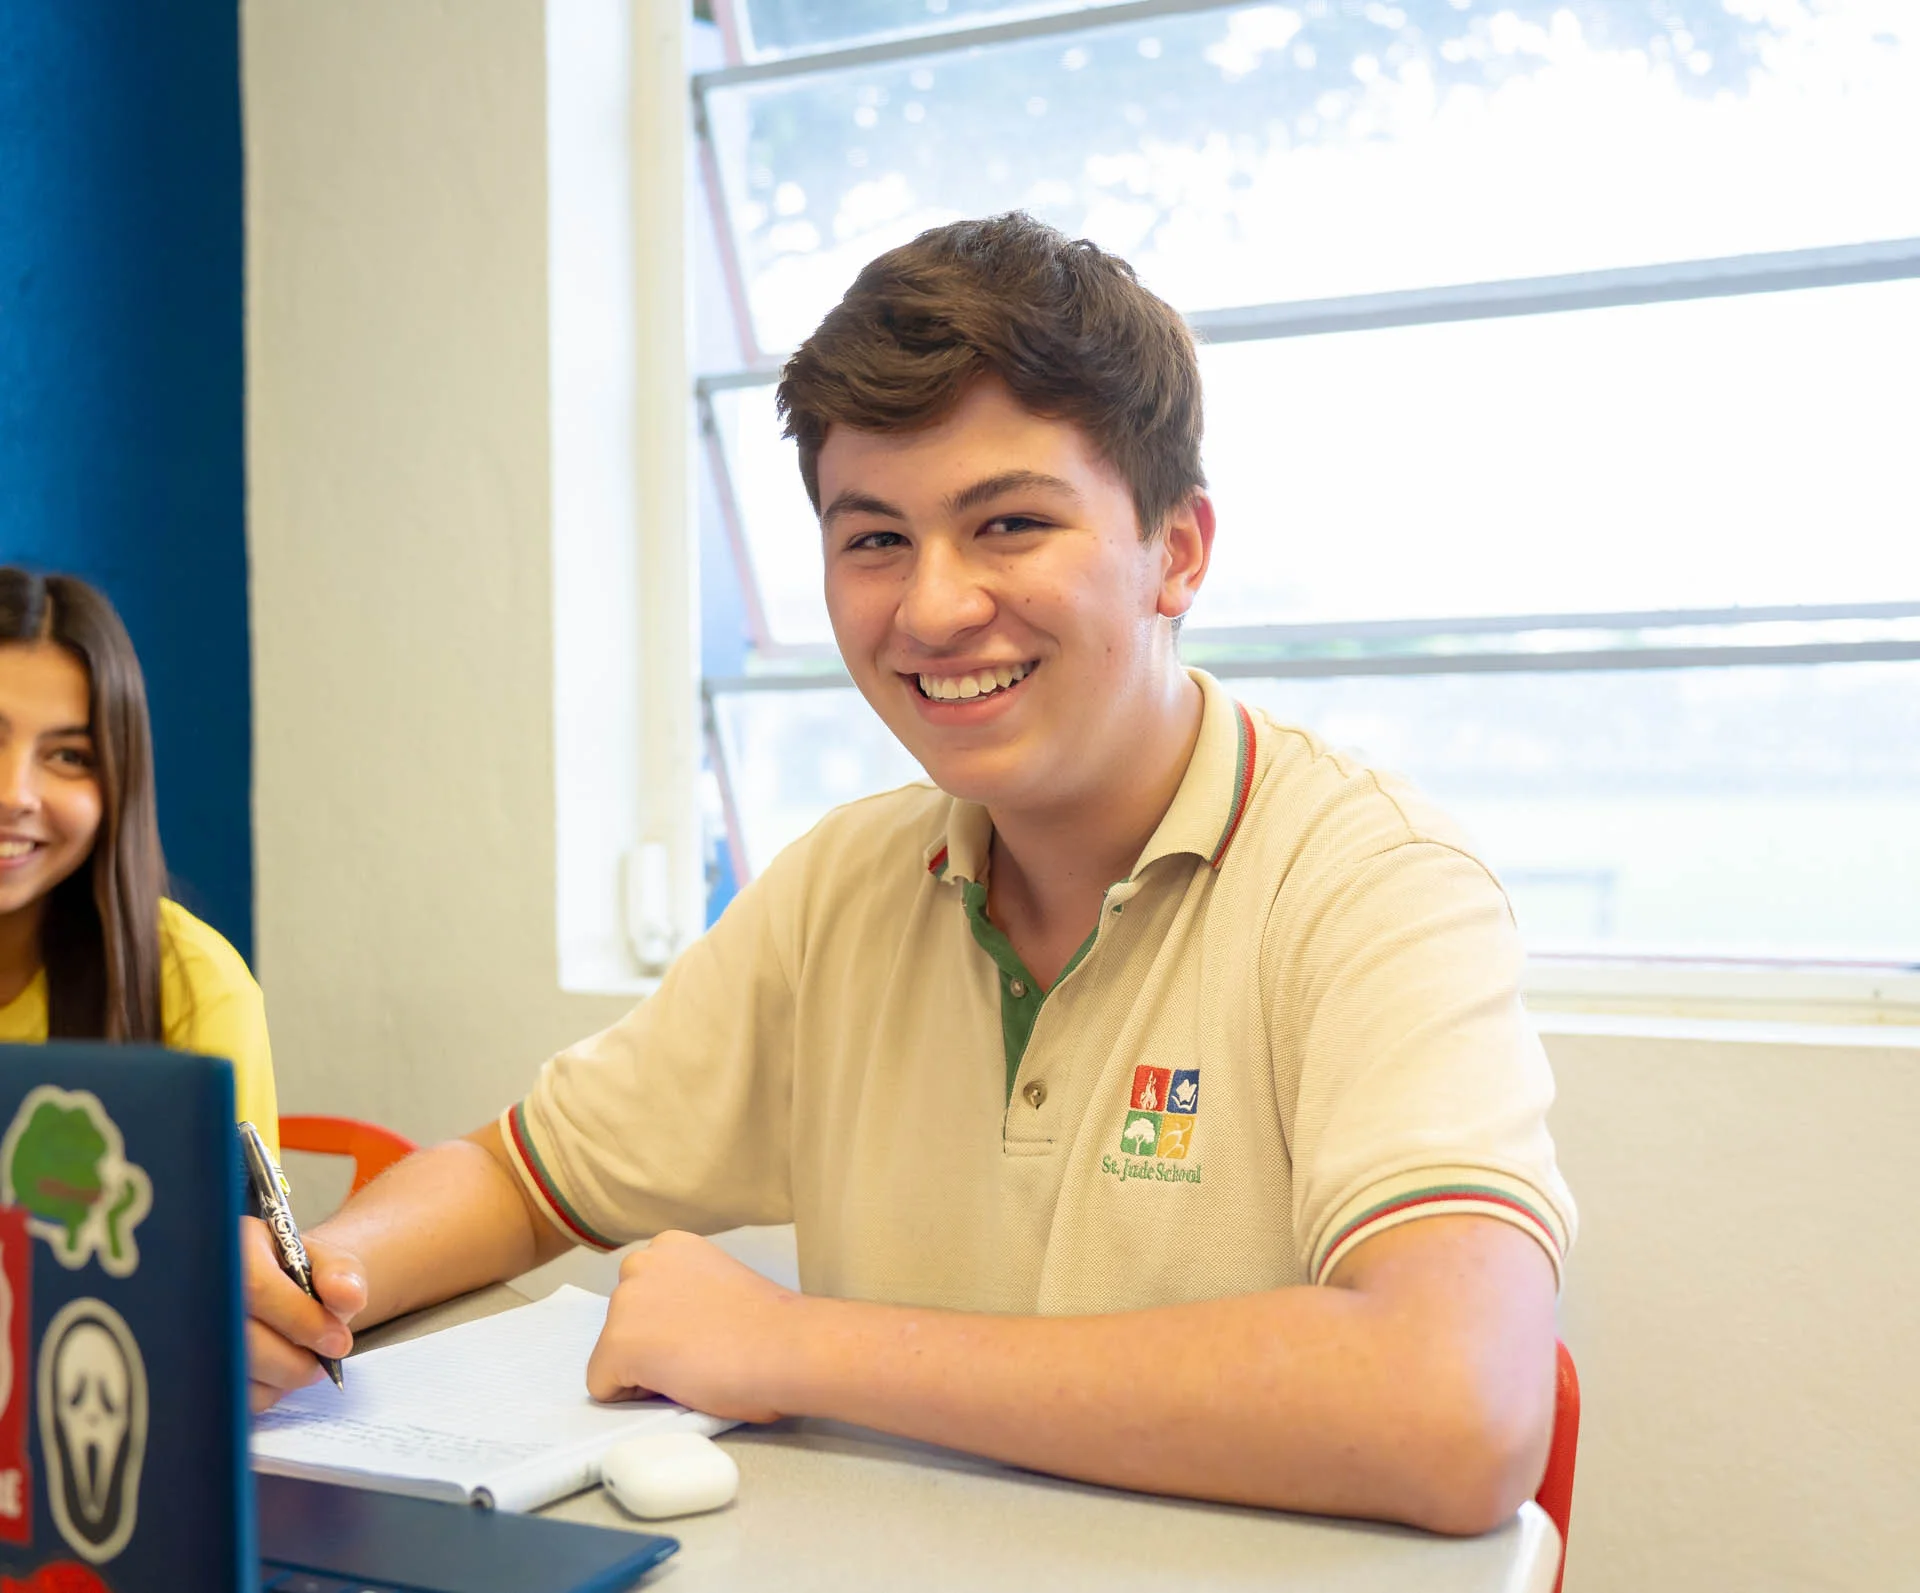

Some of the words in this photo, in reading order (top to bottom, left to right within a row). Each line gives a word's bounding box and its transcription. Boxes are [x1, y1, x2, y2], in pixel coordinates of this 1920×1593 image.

[1102, 1154, 1119, 1175] St.
[1120, 1159, 1154, 1181] Jude
[1156, 1161, 1201, 1183] School
